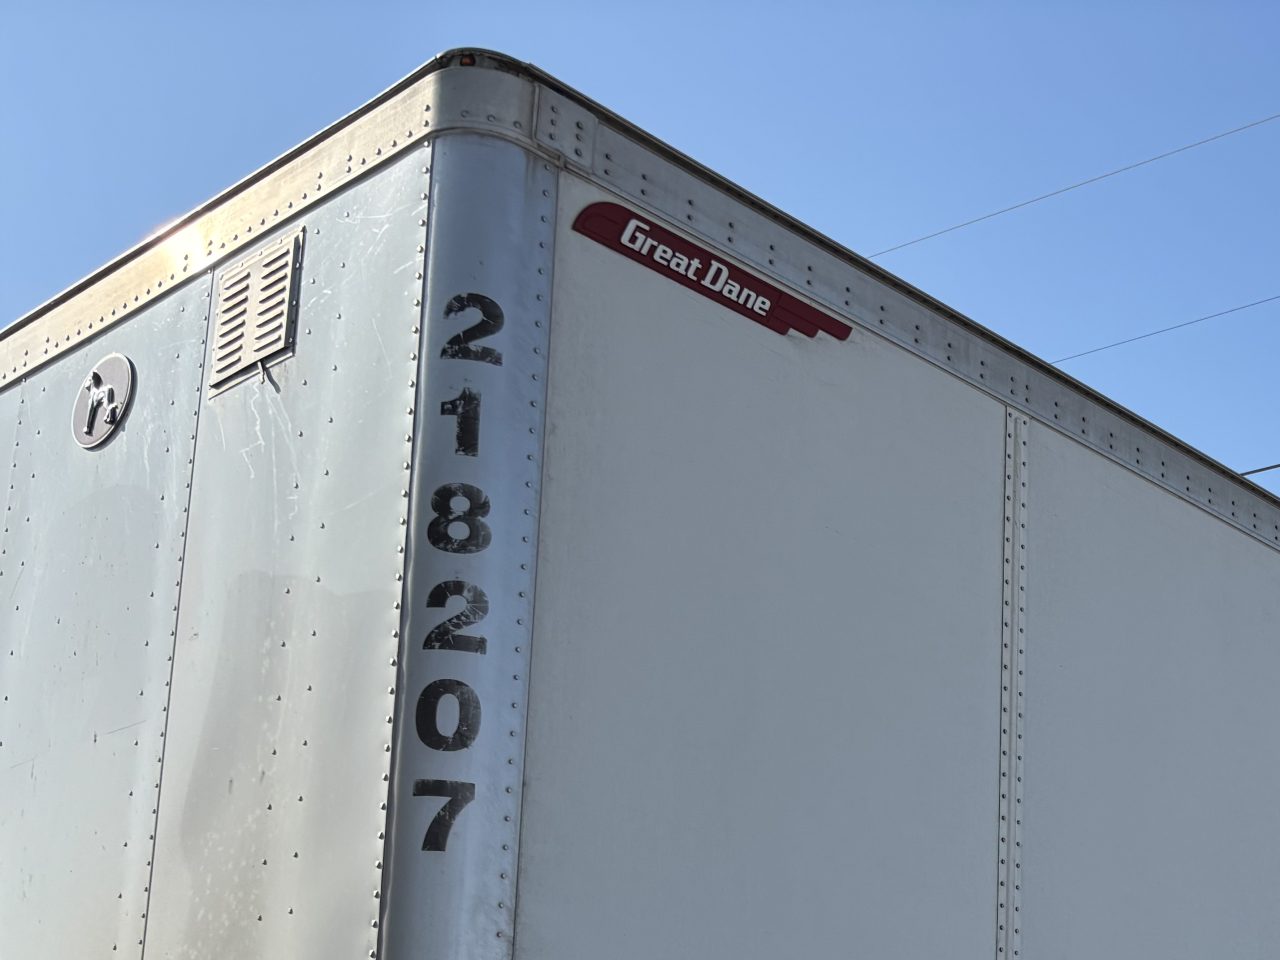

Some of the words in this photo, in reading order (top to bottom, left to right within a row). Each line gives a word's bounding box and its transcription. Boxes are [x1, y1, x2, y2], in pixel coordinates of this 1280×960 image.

[620, 219, 702, 281] Great
[701, 260, 772, 317] Dane
[412, 292, 505, 852] 218207
